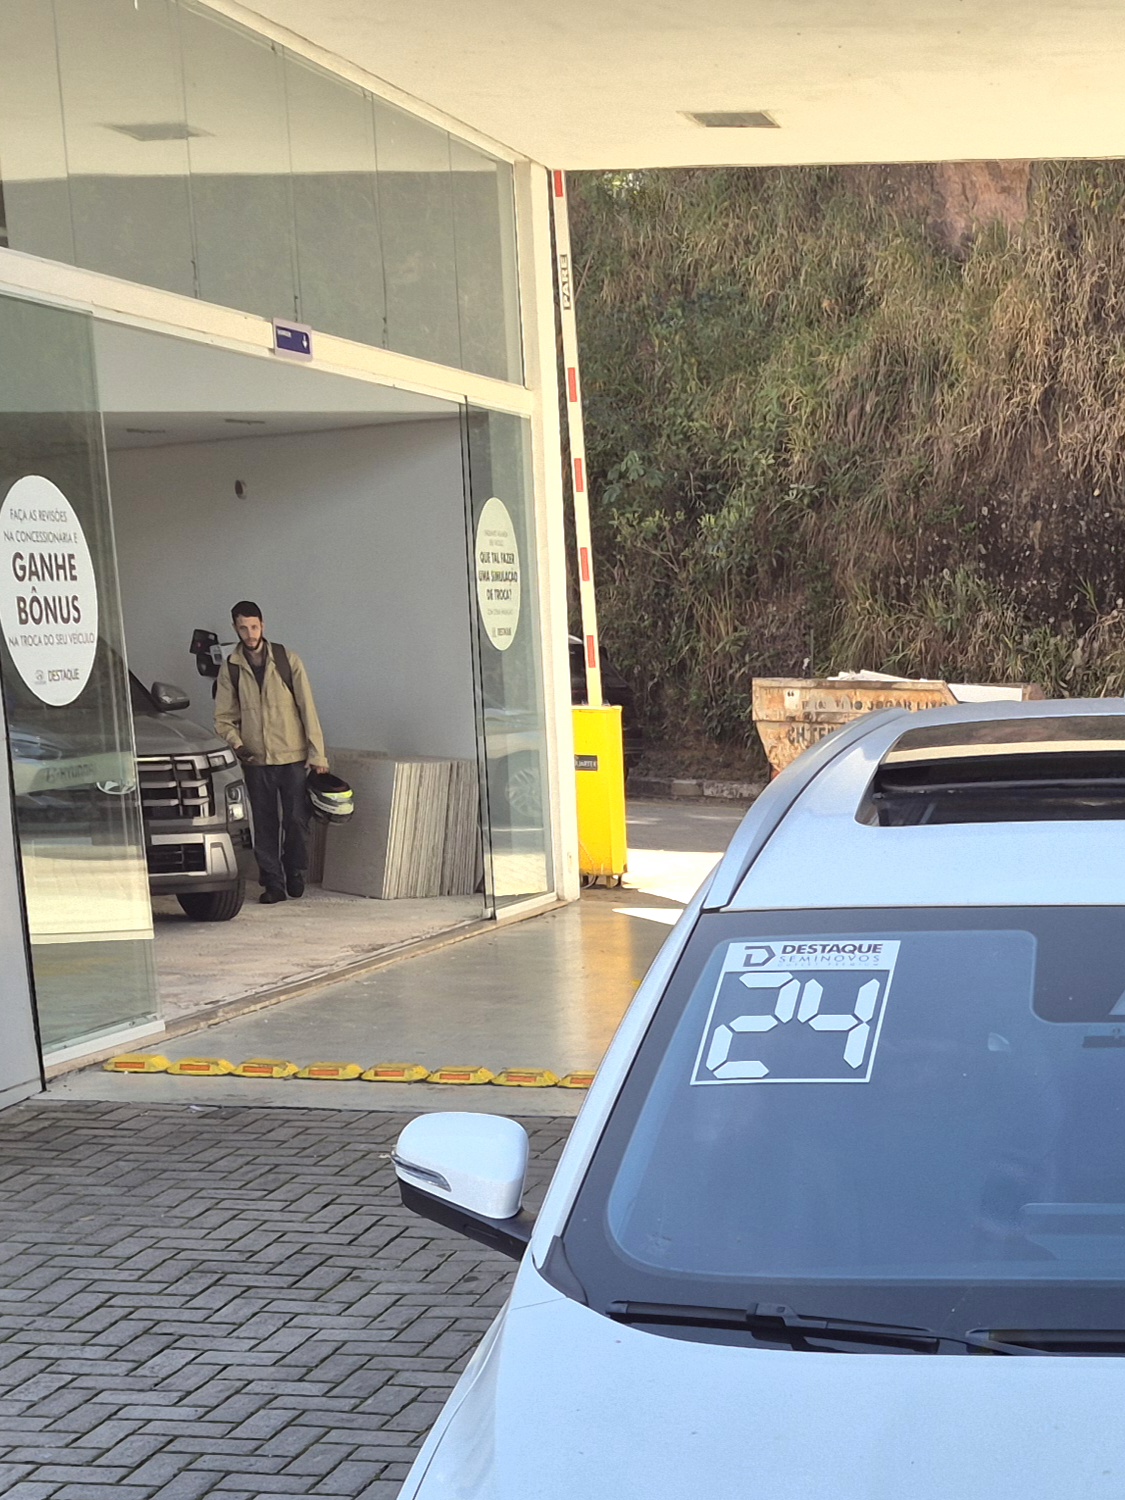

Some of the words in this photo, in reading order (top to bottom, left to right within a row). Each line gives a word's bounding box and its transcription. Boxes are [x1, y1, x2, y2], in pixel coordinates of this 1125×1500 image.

[560, 254, 571, 310] PARE
[10, 508, 27, 523] FAÇA
[29, 509, 37, 521] AS
[3, 530, 14, 541] NA
[480, 551, 491, 564] QUE
[491, 551, 500, 564] TAL
[501, 552, 515, 564] FAZER
[12, 552, 78, 582] GANHE
[16, 586, 81, 625] BÔNUS
[8, 637, 19, 647] NA
[20, 634, 43, 647] TROCA
[43, 634, 54, 645] DO
[55, 633, 67, 645] SEU
[781, 943, 884, 955] DESTAQUE
[779, 955, 880, 963] SEMINOVOS
[706, 972, 881, 1079] 24
